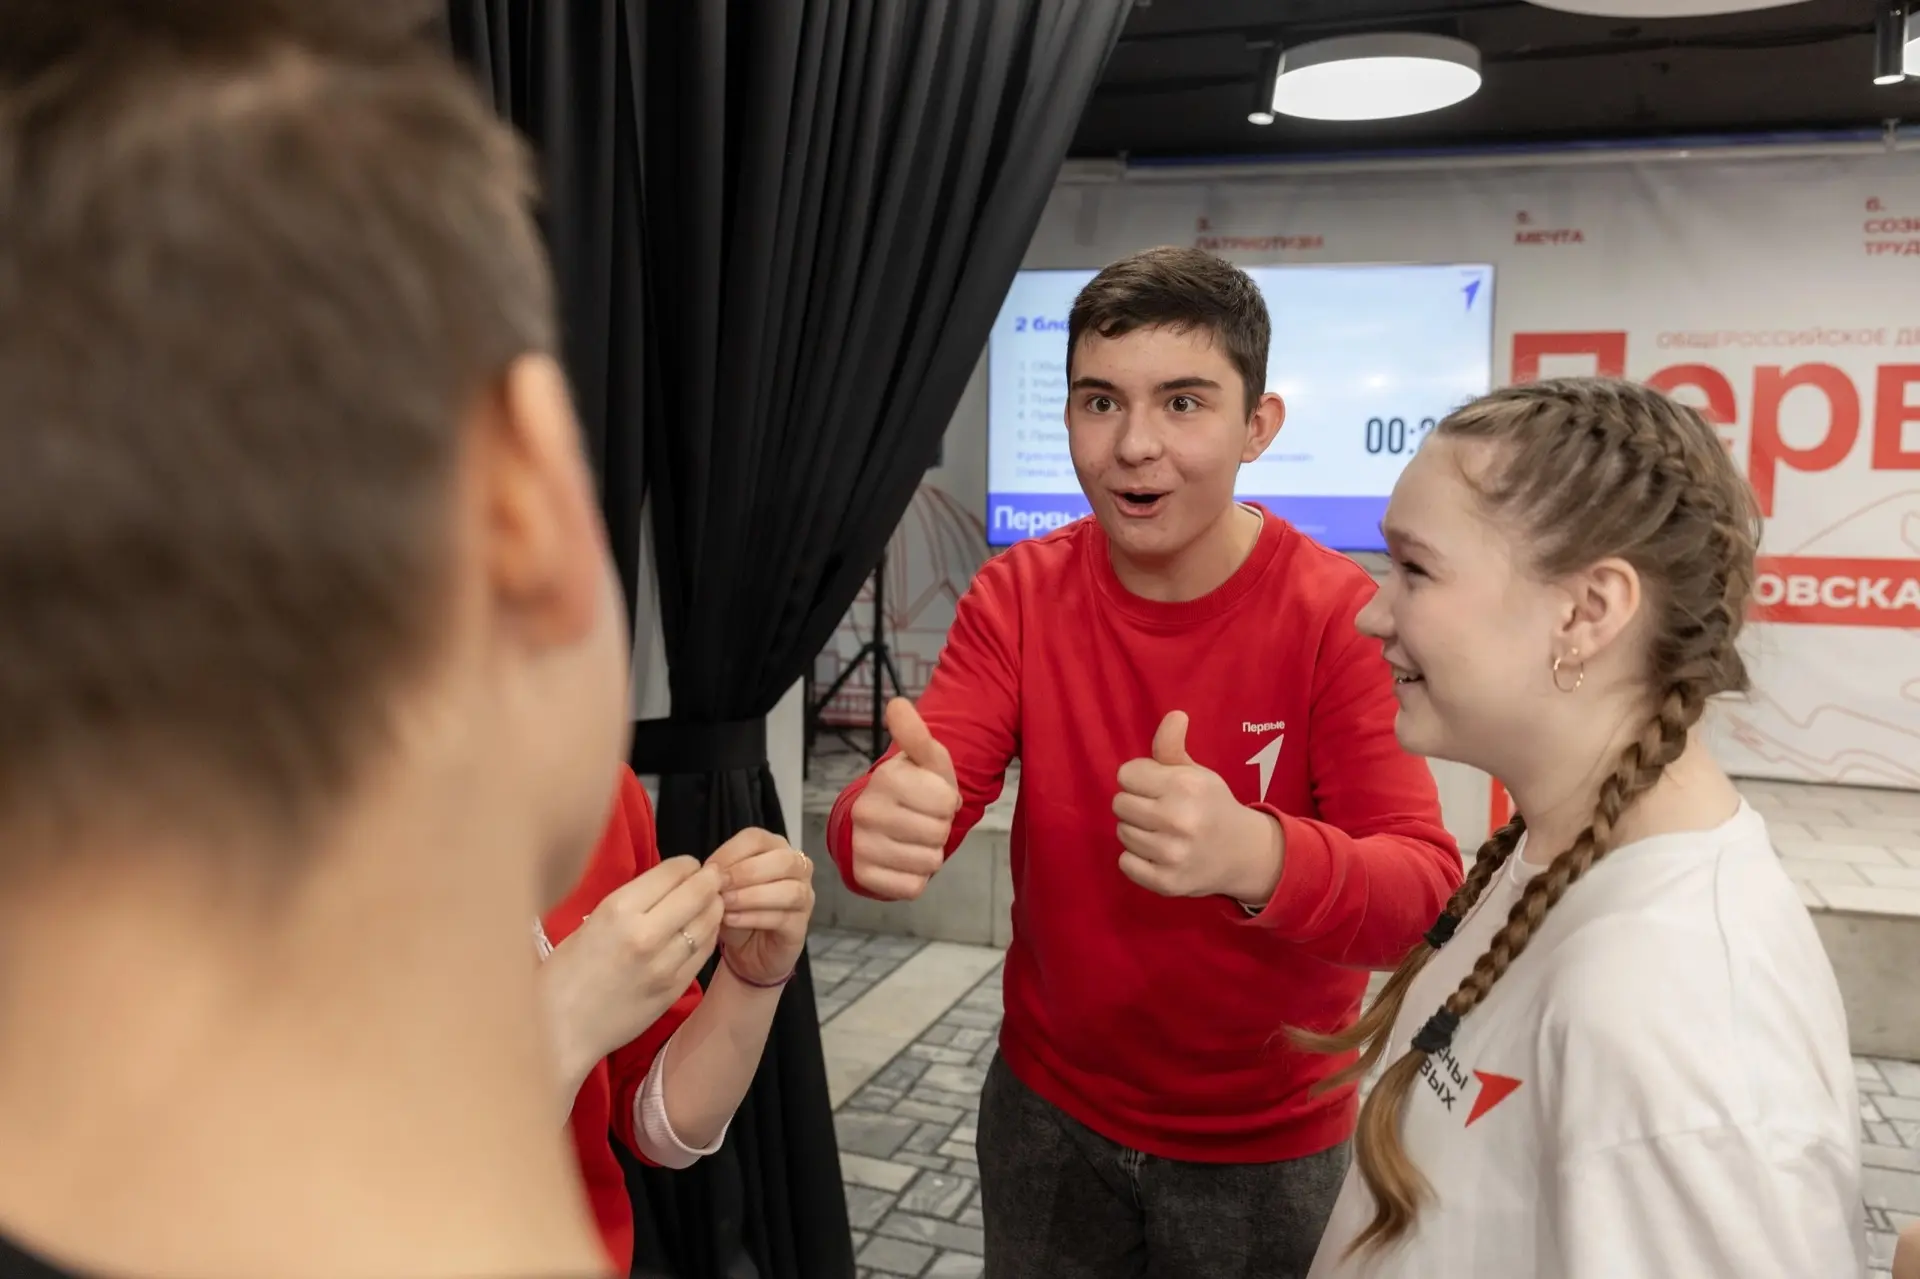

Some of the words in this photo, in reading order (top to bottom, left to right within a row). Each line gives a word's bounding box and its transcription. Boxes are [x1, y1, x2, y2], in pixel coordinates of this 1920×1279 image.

[1514, 229, 1584, 245] МЕЧТА
[1656, 326, 1887, 348] ОБЩЕРОССИЙСКОЕ
[1242, 720, 1286, 736] Первые
